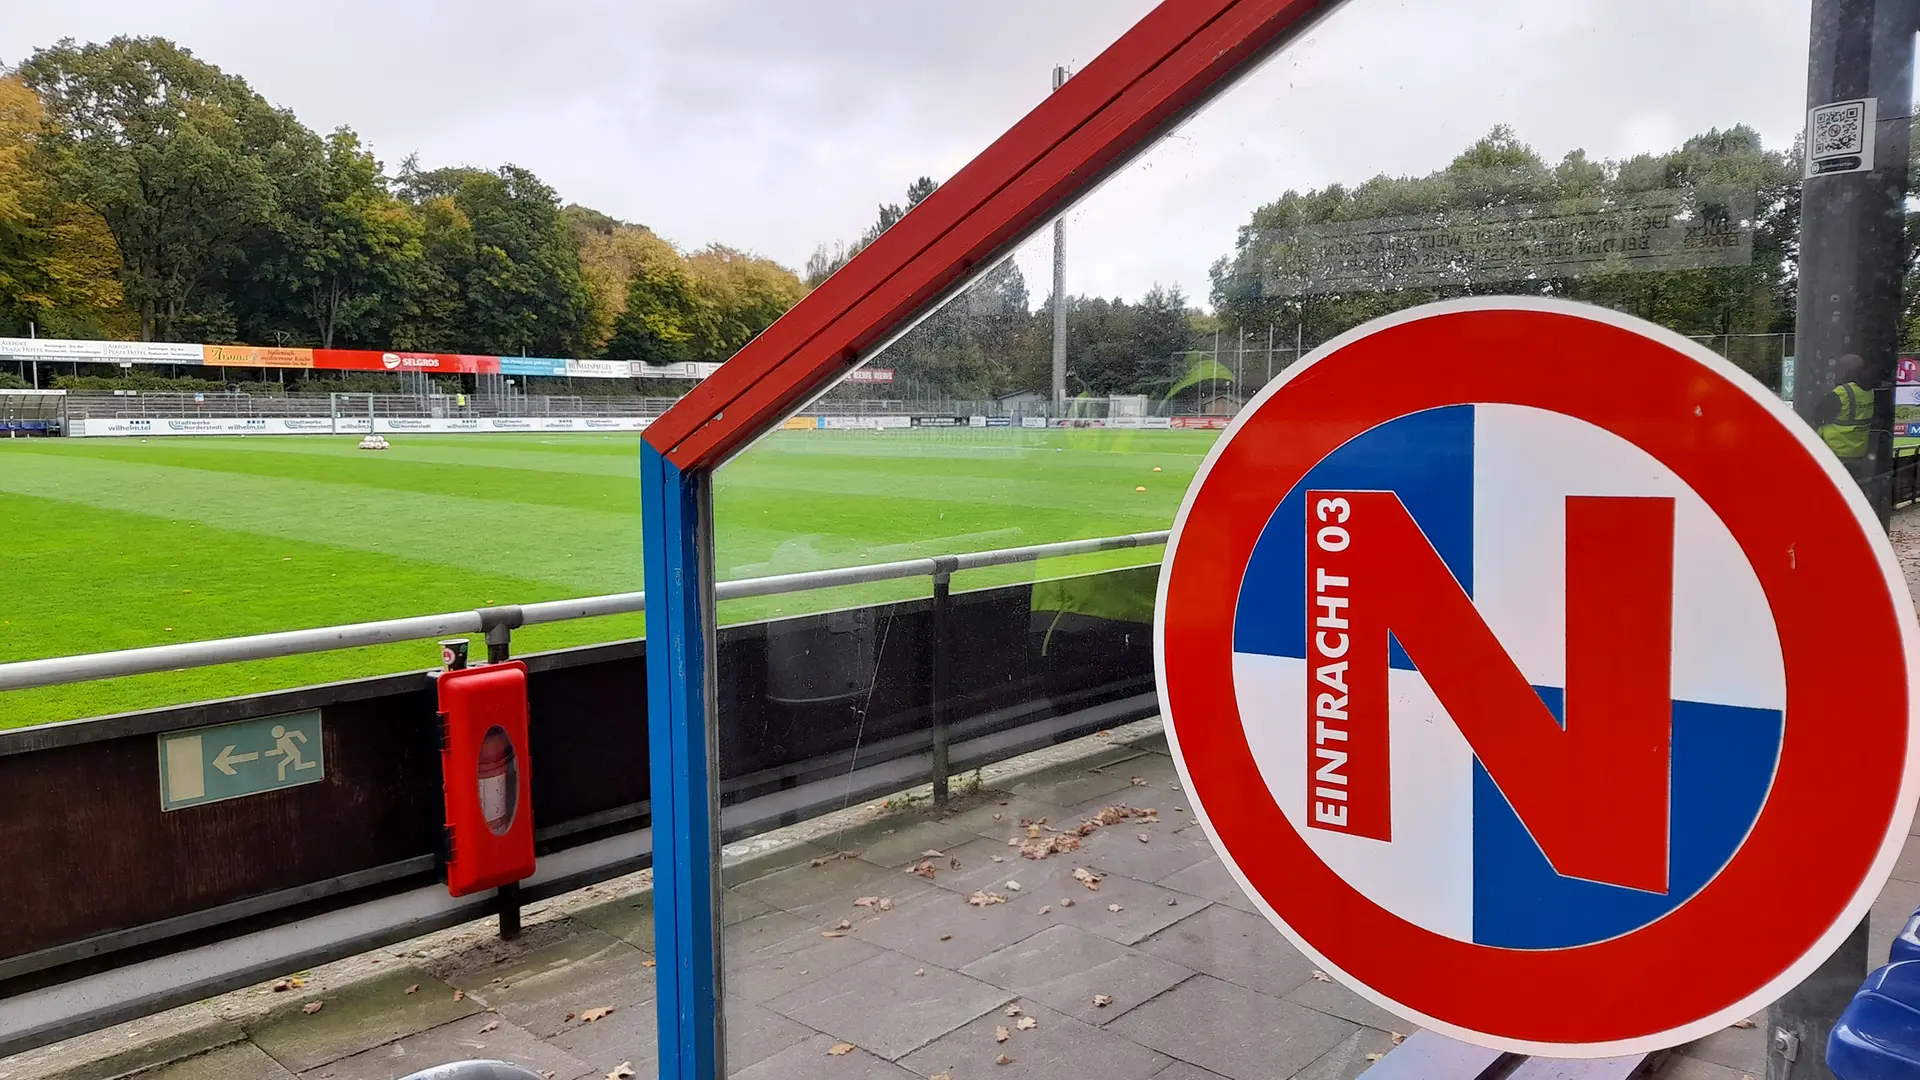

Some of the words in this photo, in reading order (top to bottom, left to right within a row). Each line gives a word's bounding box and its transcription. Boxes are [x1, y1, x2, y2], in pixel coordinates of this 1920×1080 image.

[210, 347, 249, 362] Aroma
[402, 358, 440, 367] SELGROS
[1317, 497, 1351, 553] 03
[1316, 568, 1350, 827] EINTRACHT
